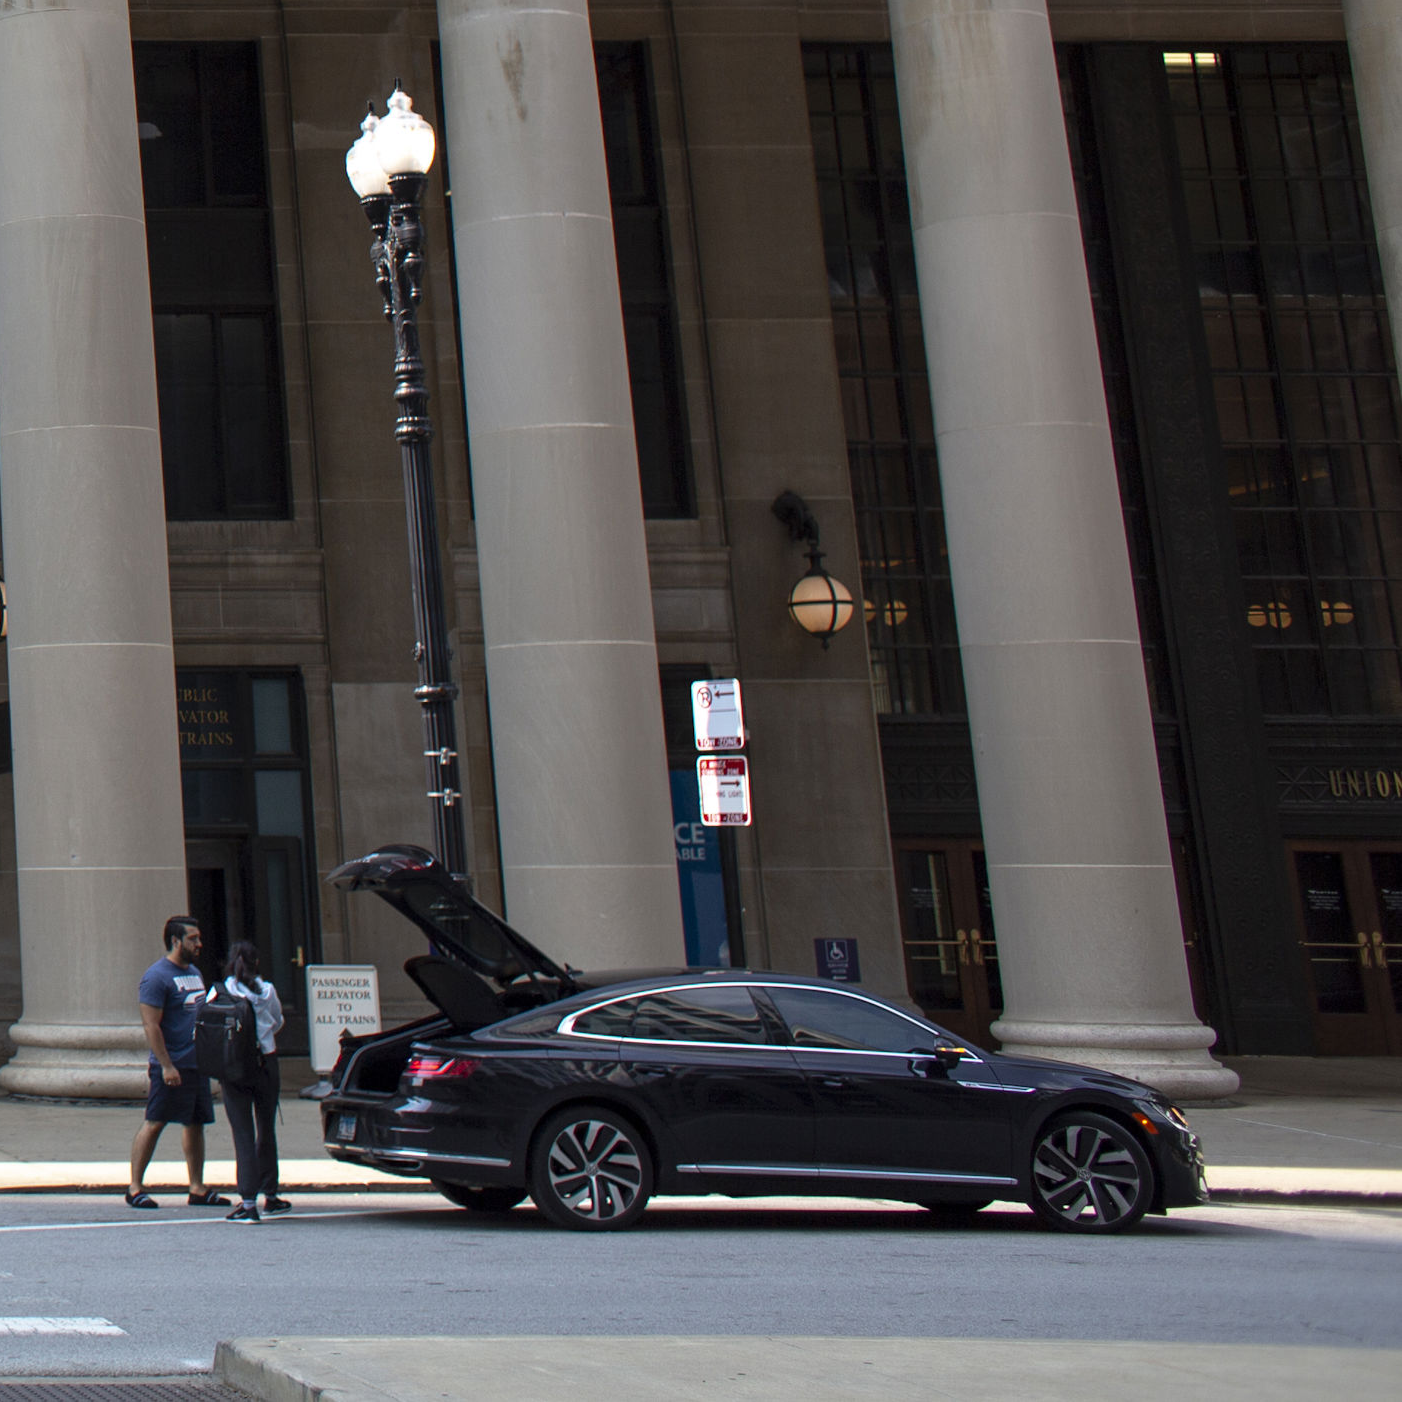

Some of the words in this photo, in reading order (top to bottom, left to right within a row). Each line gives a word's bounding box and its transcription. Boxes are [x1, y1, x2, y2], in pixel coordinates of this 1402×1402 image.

[1329, 769, 1402, 798] UNION
[311, 978, 370, 988] PASSENGER
[317, 989, 371, 1000] ELEVATOR
[337, 1003, 352, 1012] TO
[315, 1014, 335, 1024] ALL
[337, 1014, 376, 1024] TRAINS
